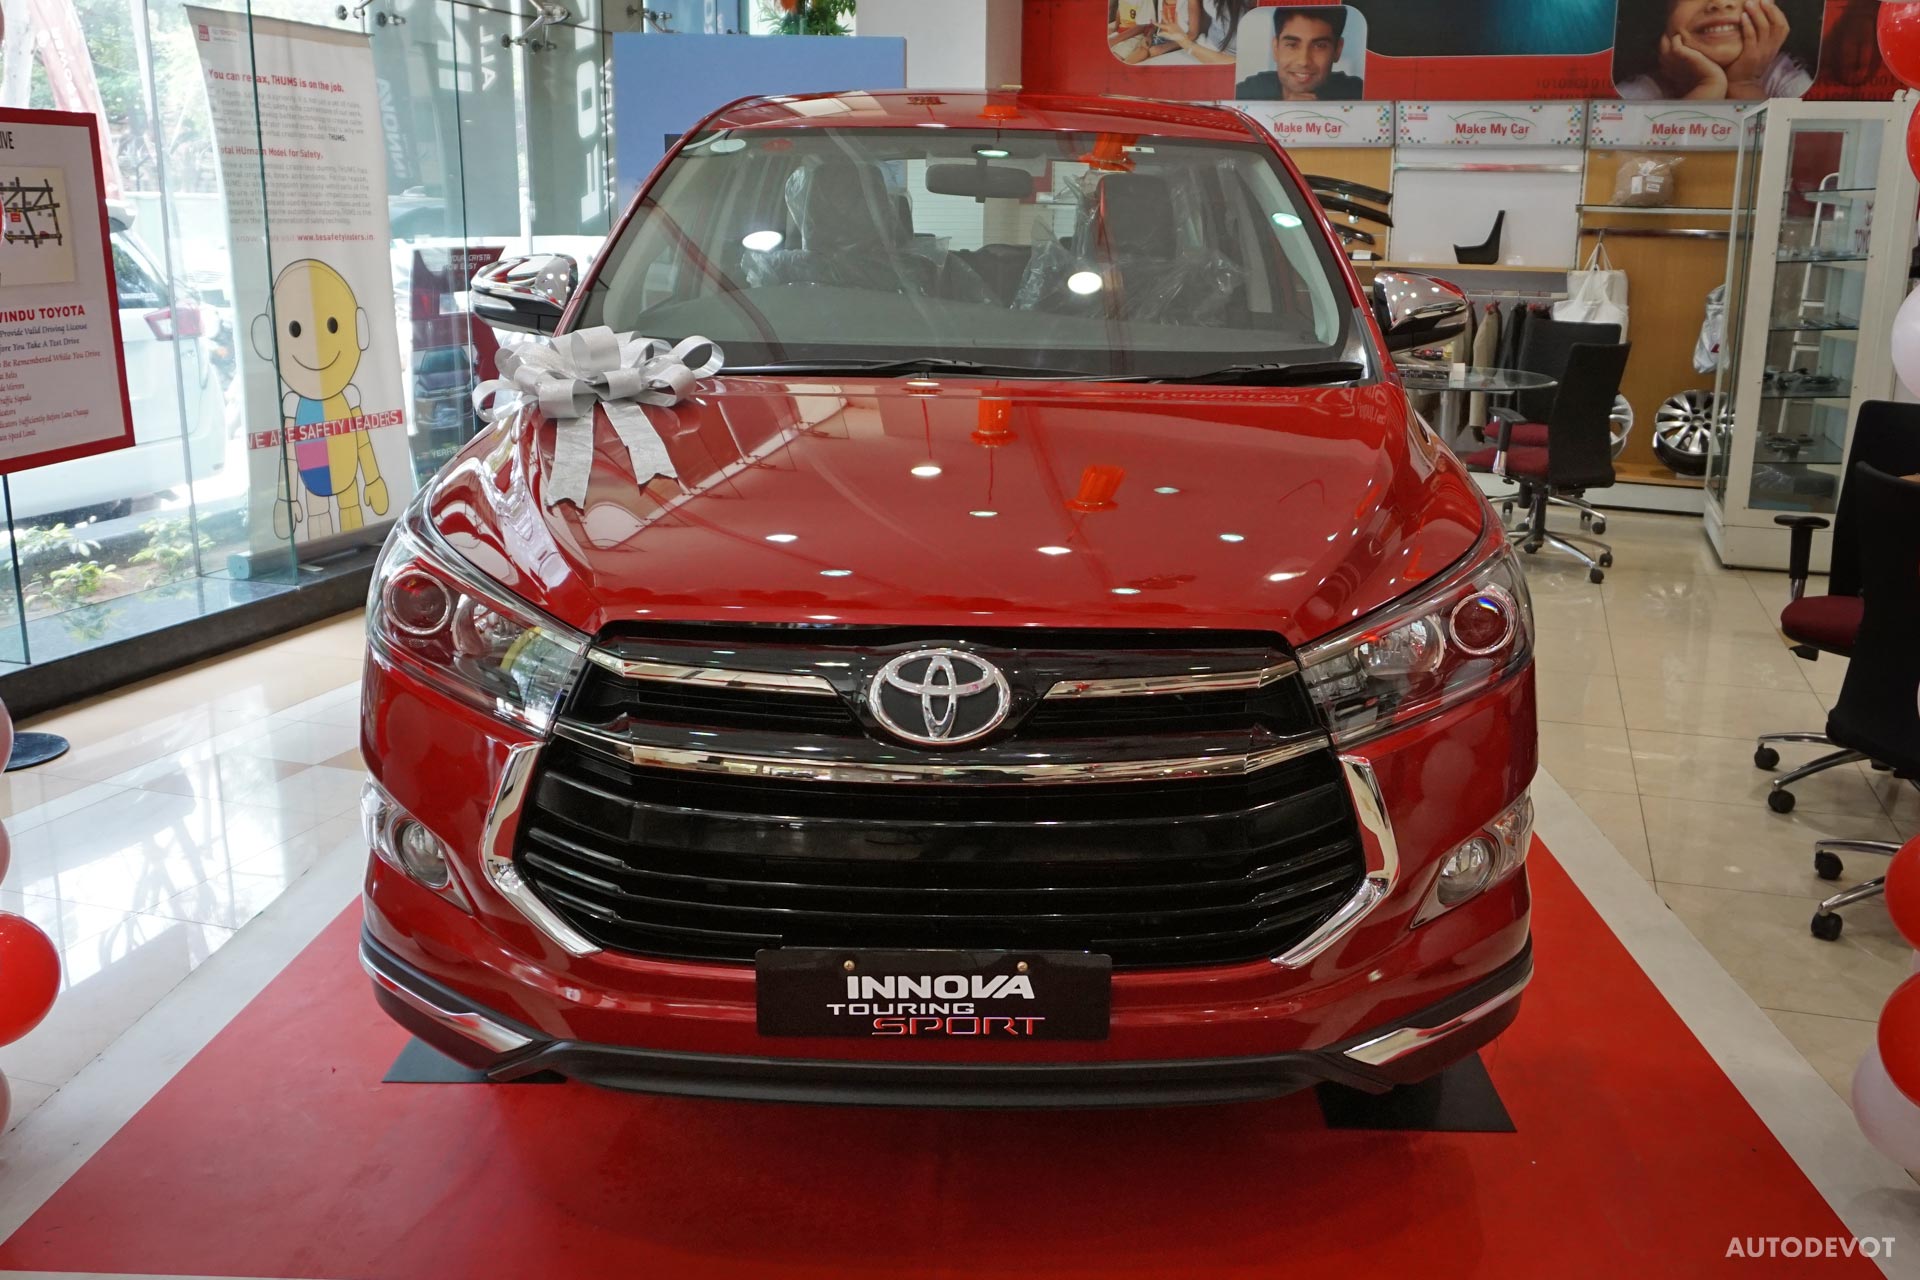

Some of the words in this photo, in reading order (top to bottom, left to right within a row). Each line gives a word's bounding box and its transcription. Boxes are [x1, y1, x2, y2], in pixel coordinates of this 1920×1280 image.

[208, 69, 224, 80] You
[226, 72, 239, 81] can
[242, 74, 270, 85] reax,
[271, 74, 297, 87] THUMS
[299, 78, 307, 88] is
[309, 80, 318, 89] on
[318, 80, 329, 91] the
[330, 82, 344, 93] job.
[1273, 122, 1302, 133] Make
[1305, 122, 1321, 136] My
[1324, 122, 1342, 133] Car
[1455, 123, 1486, 134] Make
[1490, 123, 1507, 138] My
[1510, 123, 1530, 134] Car
[1652, 124, 1686, 135] Make
[1690, 124, 1708, 138] My
[1711, 124, 1732, 135] Car
[0, 131, 15, 149] IVE
[269, 147, 287, 157] Model
[289, 148, 299, 157] for
[299, 149, 324, 160] Safety.
[39, 304, 85, 319] TOYOTA
[24, 325, 41, 335] Valid
[42, 325, 65, 334] Driving
[12, 343, 25, 351] You
[26, 341, 41, 349] Take
[49, 339, 62, 347] Test
[63, 338, 80, 346] Drive
[3, 360, 11, 368] Be
[13, 354, 52, 366] Remembered
[52, 353, 71, 362] While
[298, 419, 344, 440] SAFETY
[349, 410, 399, 432] LEADERS
[846, 975, 1035, 1000] INNOVA
[826, 1002, 975, 1015] TOURING
[872, 1015, 1046, 1035] SPORT
